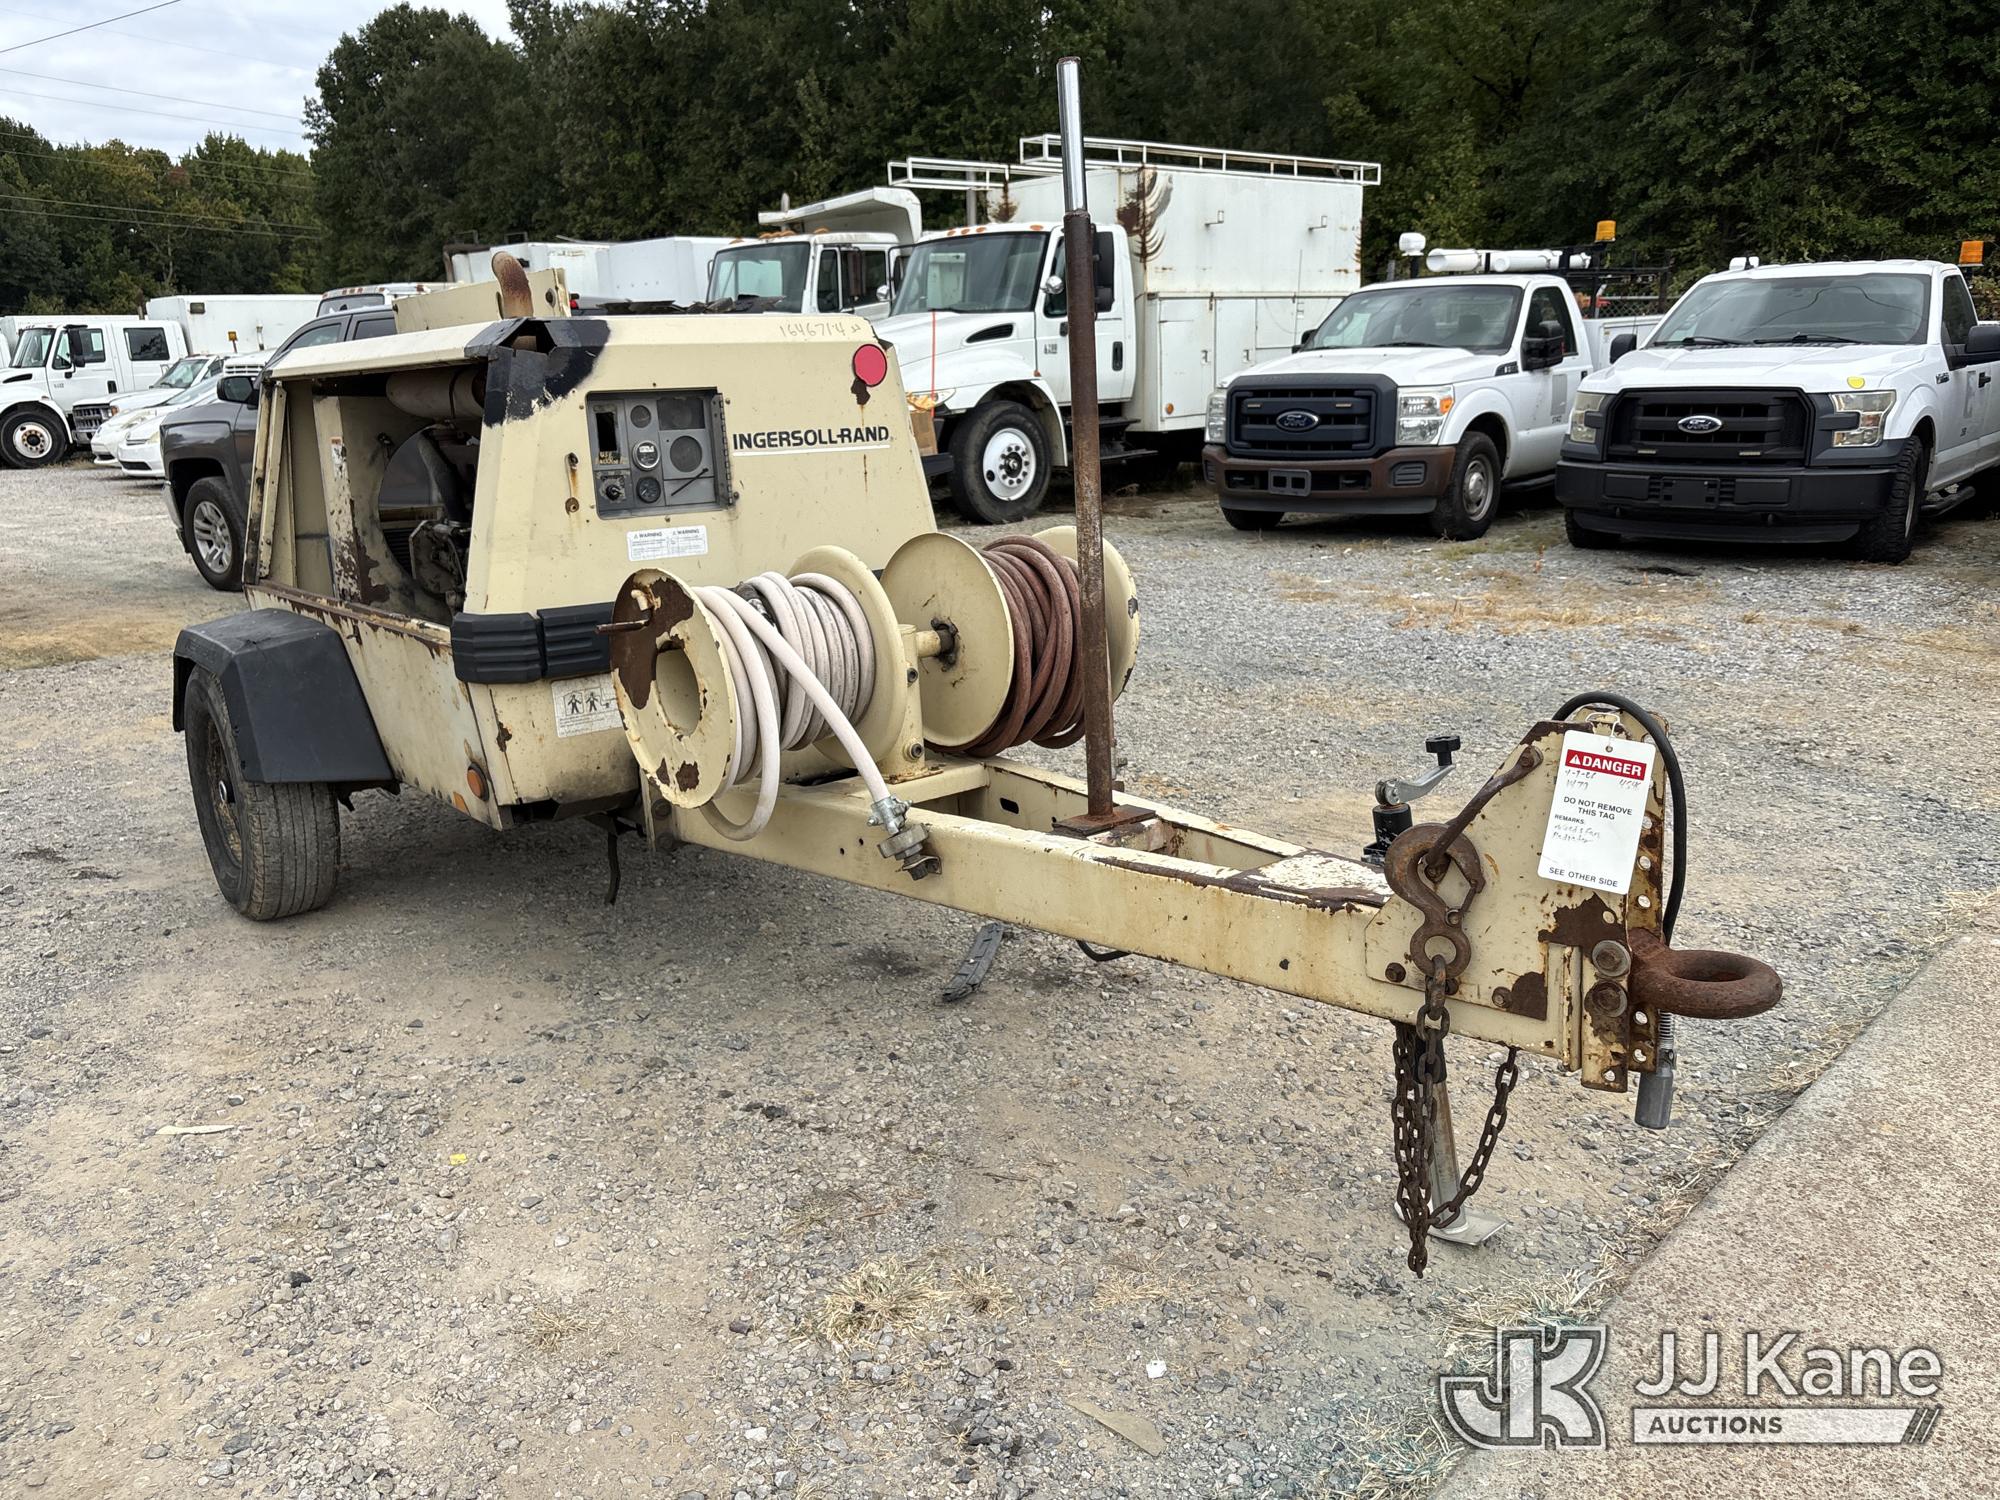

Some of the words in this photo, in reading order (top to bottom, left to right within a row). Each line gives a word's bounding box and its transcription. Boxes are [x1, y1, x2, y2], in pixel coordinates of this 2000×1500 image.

[732, 426, 889, 450] INGERSOLL-RAND
[1582, 755, 1642, 777] DANGER
[1563, 796, 1576, 805] DO
[1577, 799, 1596, 808] NOT
[1597, 802, 1633, 816] REMOVE
[1578, 807, 1597, 817] THIS
[1599, 811, 1615, 821] TAG
[1549, 867, 1565, 876] SEE
[1568, 871, 1596, 883] OTHER
[1598, 877, 1618, 888] SIDE
